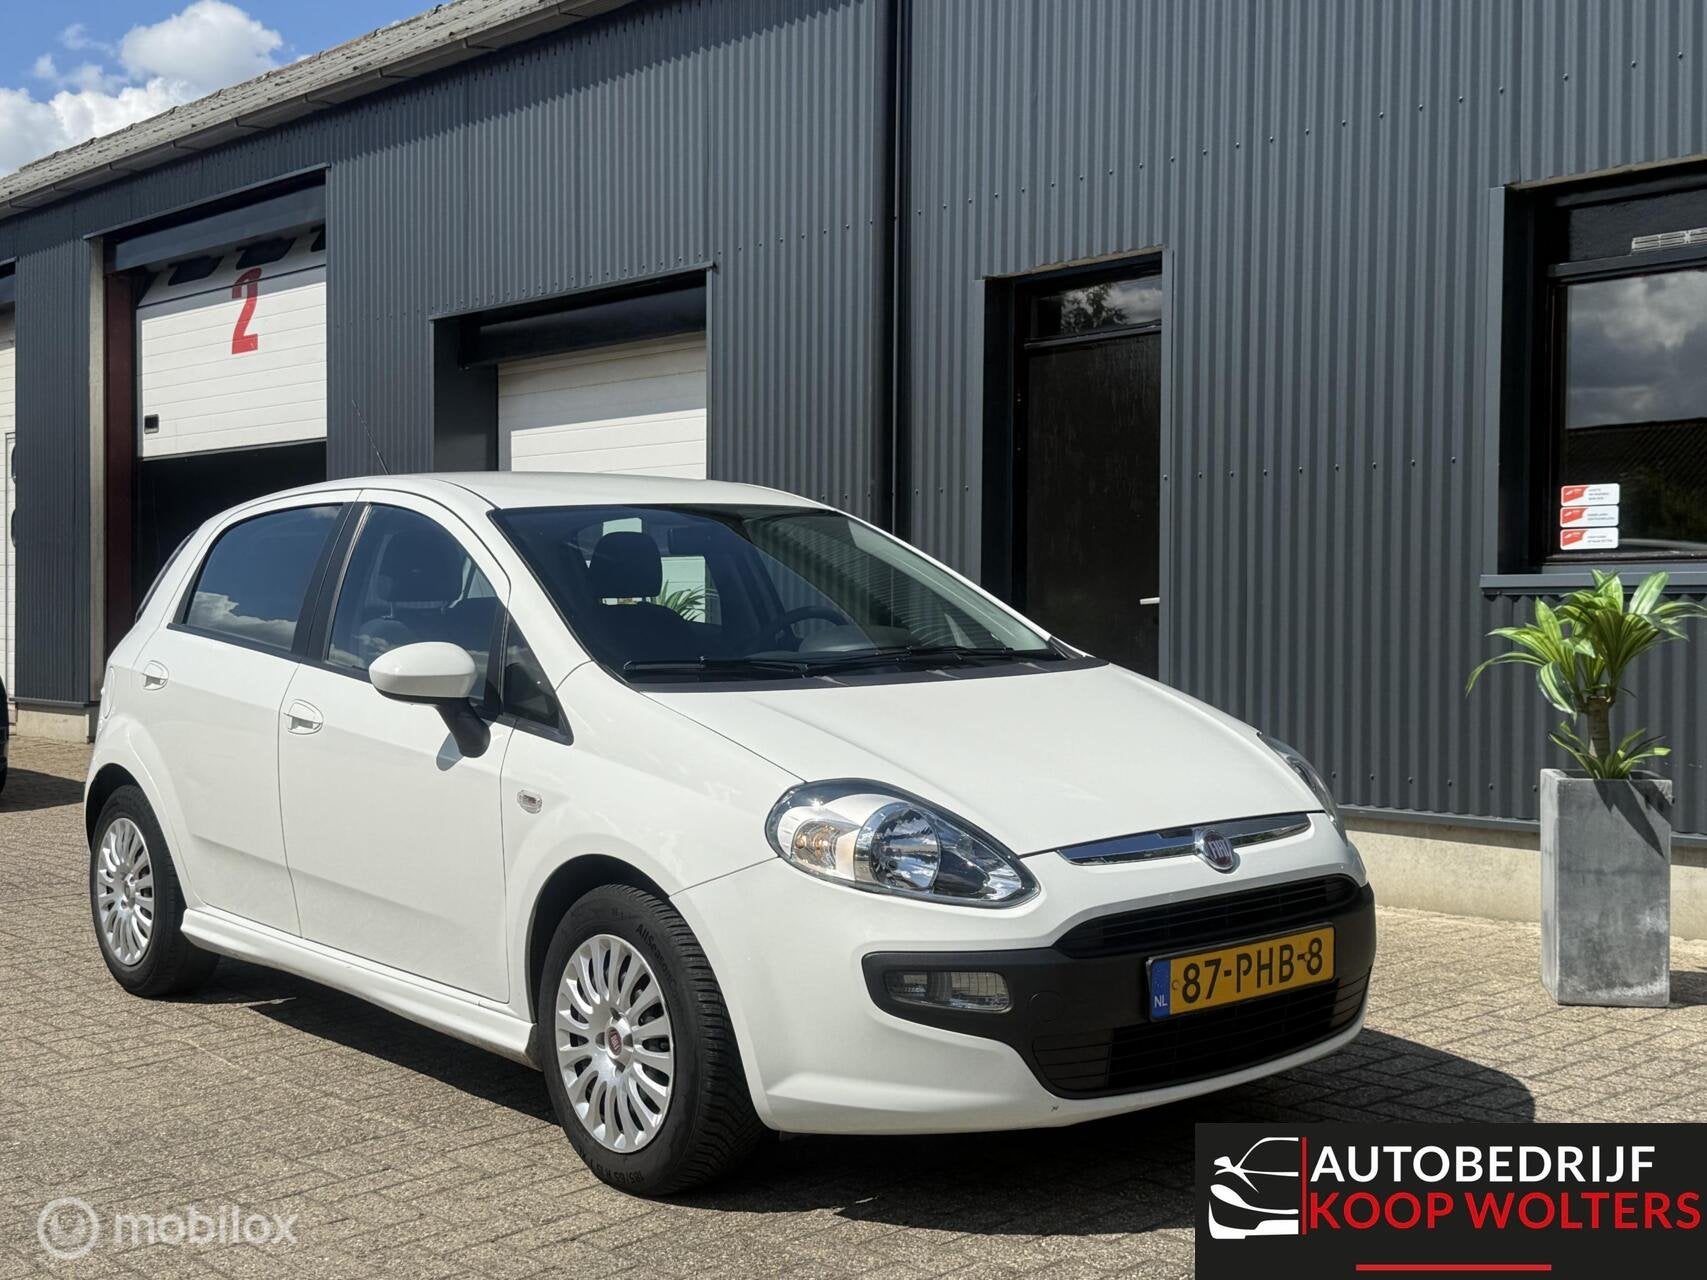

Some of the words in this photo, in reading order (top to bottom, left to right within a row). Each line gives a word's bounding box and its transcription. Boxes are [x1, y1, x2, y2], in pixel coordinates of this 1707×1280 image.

[231, 267, 262, 355] 2
[1154, 995, 1168, 1007] NL
[1182, 937, 1323, 1004] 87-PHB-8
